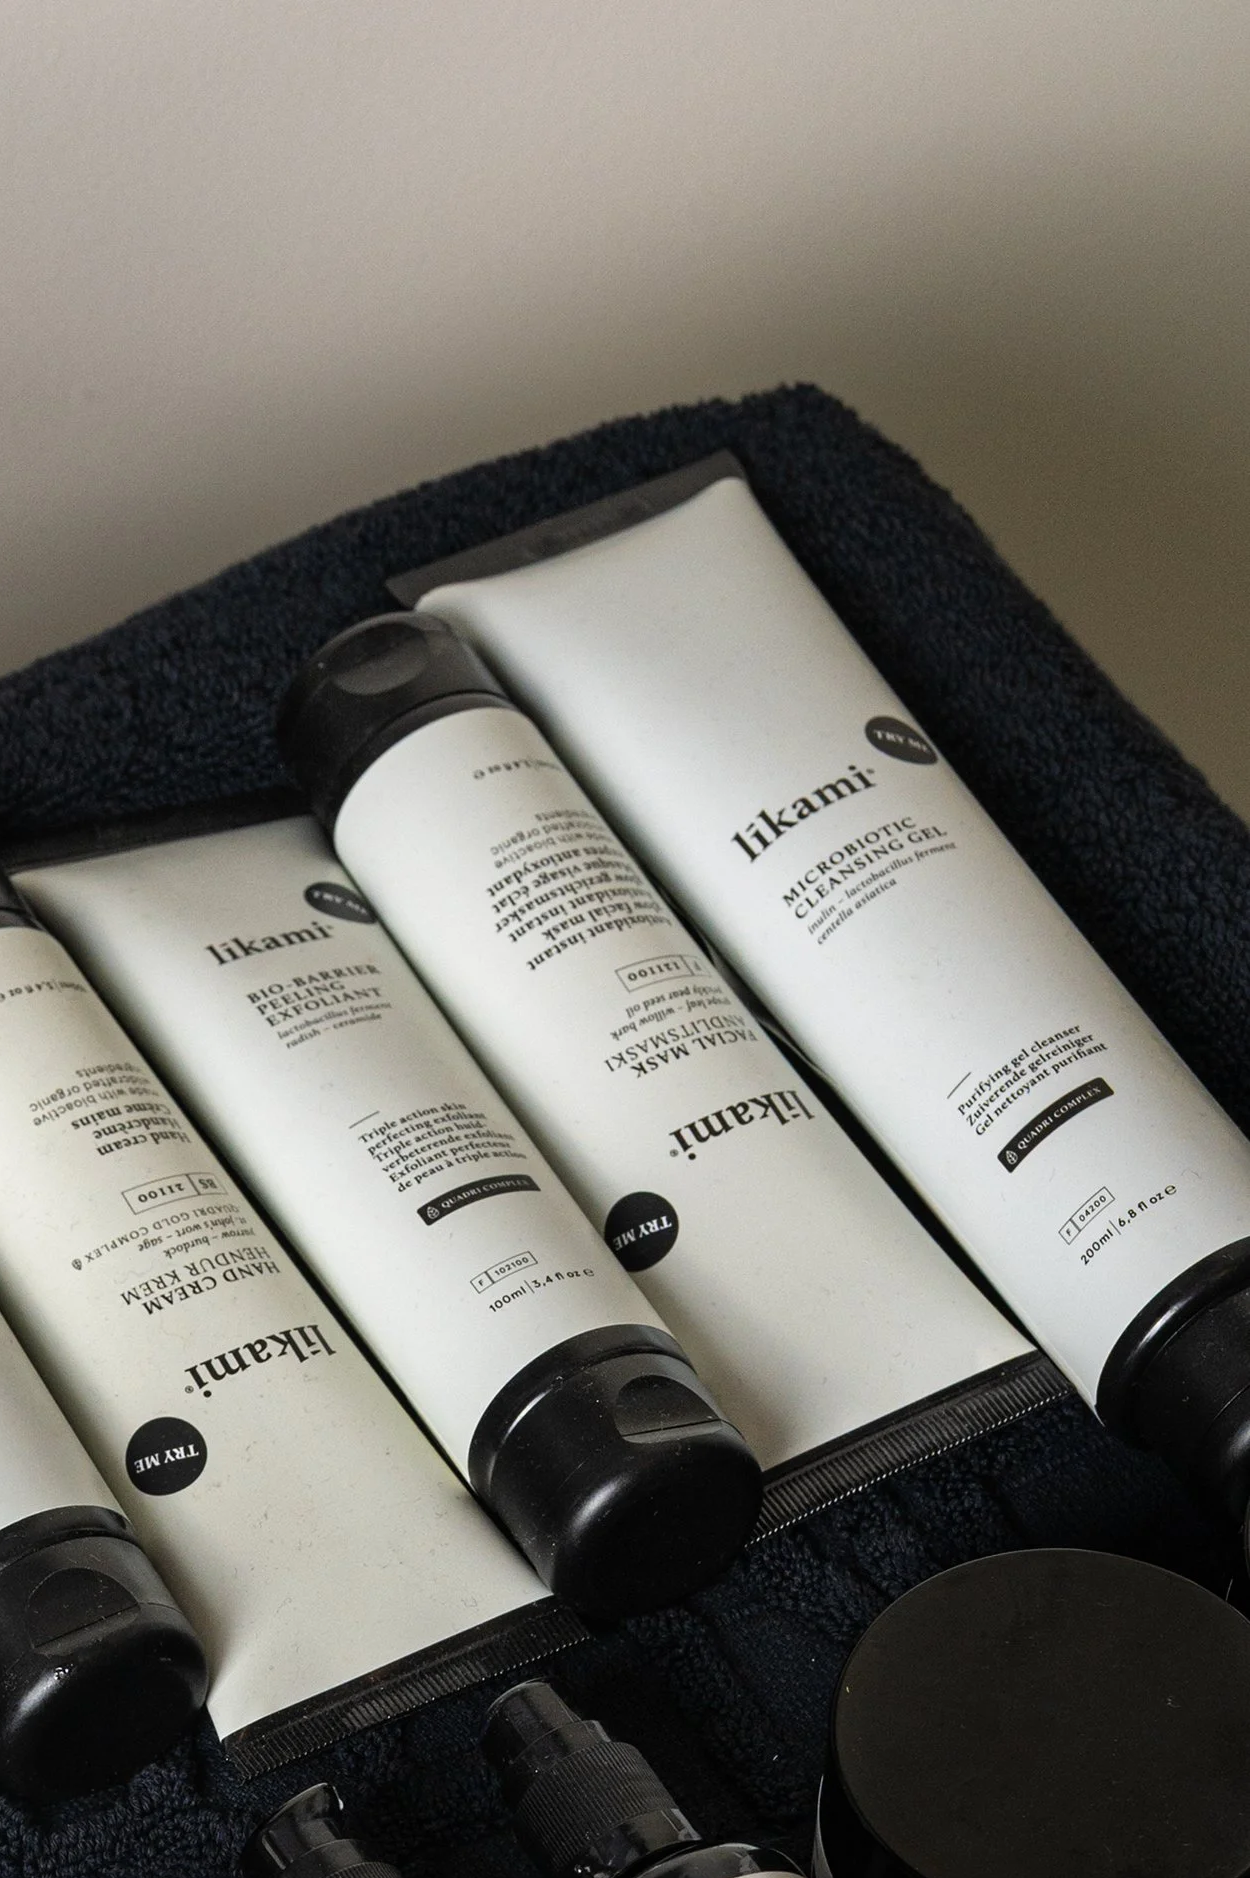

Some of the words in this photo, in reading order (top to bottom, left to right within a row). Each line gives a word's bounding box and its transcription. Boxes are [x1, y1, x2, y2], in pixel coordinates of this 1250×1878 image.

[783, 817, 916, 908] MICROBIOTIC
[794, 839, 904, 919] CLEANSING
[907, 826, 948, 846] GEL
[808, 904, 836, 935] inulin
[845, 854, 914, 901] lactobacillus
[817, 907, 854, 944] centella
[855, 877, 897, 909] asiatica
[508, 897, 566, 943] instant
[541, 914, 586, 940] mask
[526, 925, 588, 970] instant
[247, 963, 381, 1004] BIO-BARRIER
[256, 980, 346, 1016] PEELING
[266, 987, 383, 1027] EXFOLIANT
[604, 1014, 746, 1072] ANDLITSMASKI
[692, 1029, 758, 1051] FACIAL
[630, 1044, 690, 1078] MASK
[957, 1062, 1012, 1116] Purifying
[1011, 1048, 1030, 1069] gel
[1030, 1025, 1081, 1054] cleanser
[966, 1067, 1027, 1127] Zuiverende
[1028, 1033, 1094, 1073] gelreiniger
[975, 1113, 995, 1136] Gel
[994, 1068, 1052, 1115] nettoyant
[1051, 1042, 1108, 1075] purifiant
[71, 1106, 122, 1130] mains
[358, 1118, 398, 1145] Triple
[400, 1105, 440, 1127] action
[1017, 1115, 1054, 1150] QUADRI
[1053, 1086, 1102, 1119] COMPLEX
[96, 1135, 148, 1156] cream
[368, 1120, 432, 1156] perfecting
[373, 1136, 414, 1164] Triple
[414, 1124, 455, 1146] action
[382, 1132, 463, 1174] verbeterende
[388, 1150, 449, 1184] Exfoliant
[414, 1165, 444, 1185] peau
[138, 1182, 185, 1203] 21100
[441, 1186, 482, 1209] QUADRI
[1079, 1194, 1107, 1223] 04200
[153, 1213, 190, 1230] GOLD
[638, 1215, 672, 1239] TRY
[86, 1226, 149, 1264] COMPLEX
[165, 1231, 210, 1258] burdock
[613, 1230, 637, 1251] ME
[1080, 1228, 1114, 1265] 200ml
[183, 1246, 272, 1277] HENDUR
[222, 1260, 281, 1283] HAND
[494, 1256, 529, 1276] 102100
[120, 1269, 181, 1305] KREM
[142, 1275, 218, 1315] CREAM
[488, 1285, 527, 1313] 100ml
[134, 1450, 161, 1473] ME
[164, 1443, 199, 1464] TRY
